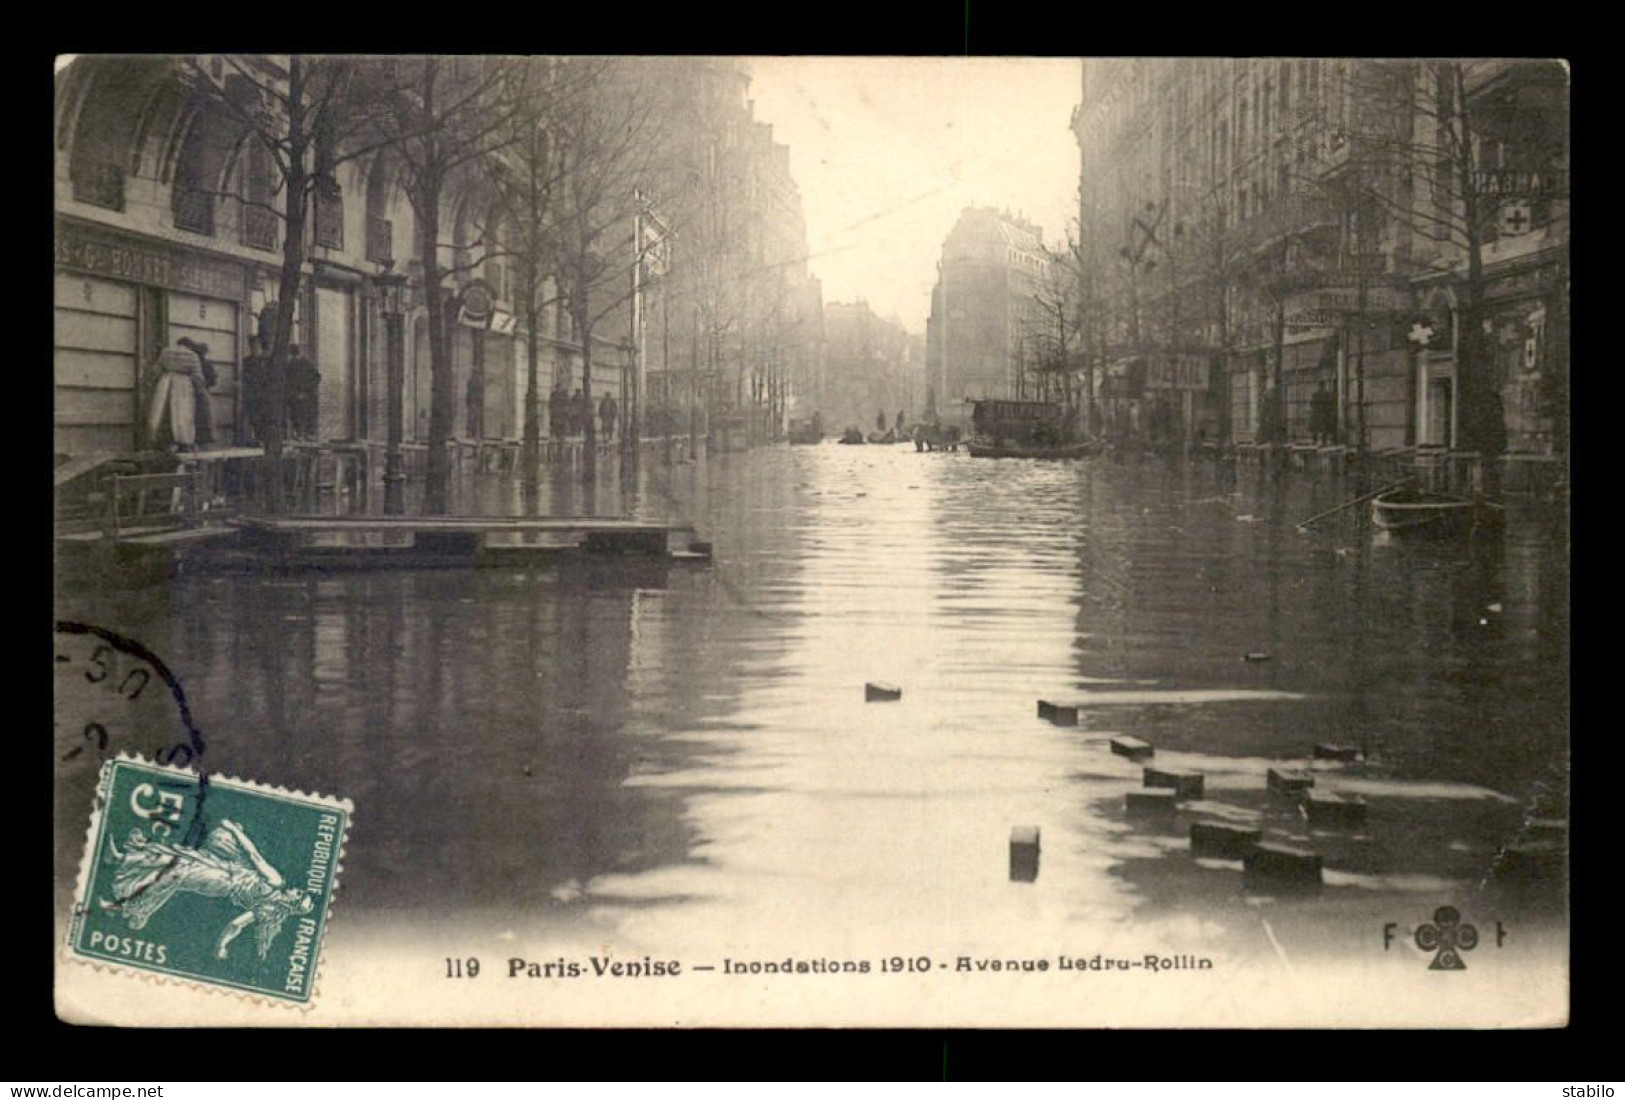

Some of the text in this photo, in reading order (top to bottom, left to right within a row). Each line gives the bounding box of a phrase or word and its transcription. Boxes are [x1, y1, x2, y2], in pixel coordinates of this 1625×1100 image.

[306, 813, 337, 895] REPUBLIQUE
[90, 930, 168, 965] POSTES
[446, 955, 1212, 978] 119 Paris-Venise Inondations 1910 Avenue Ledru-Rollin
